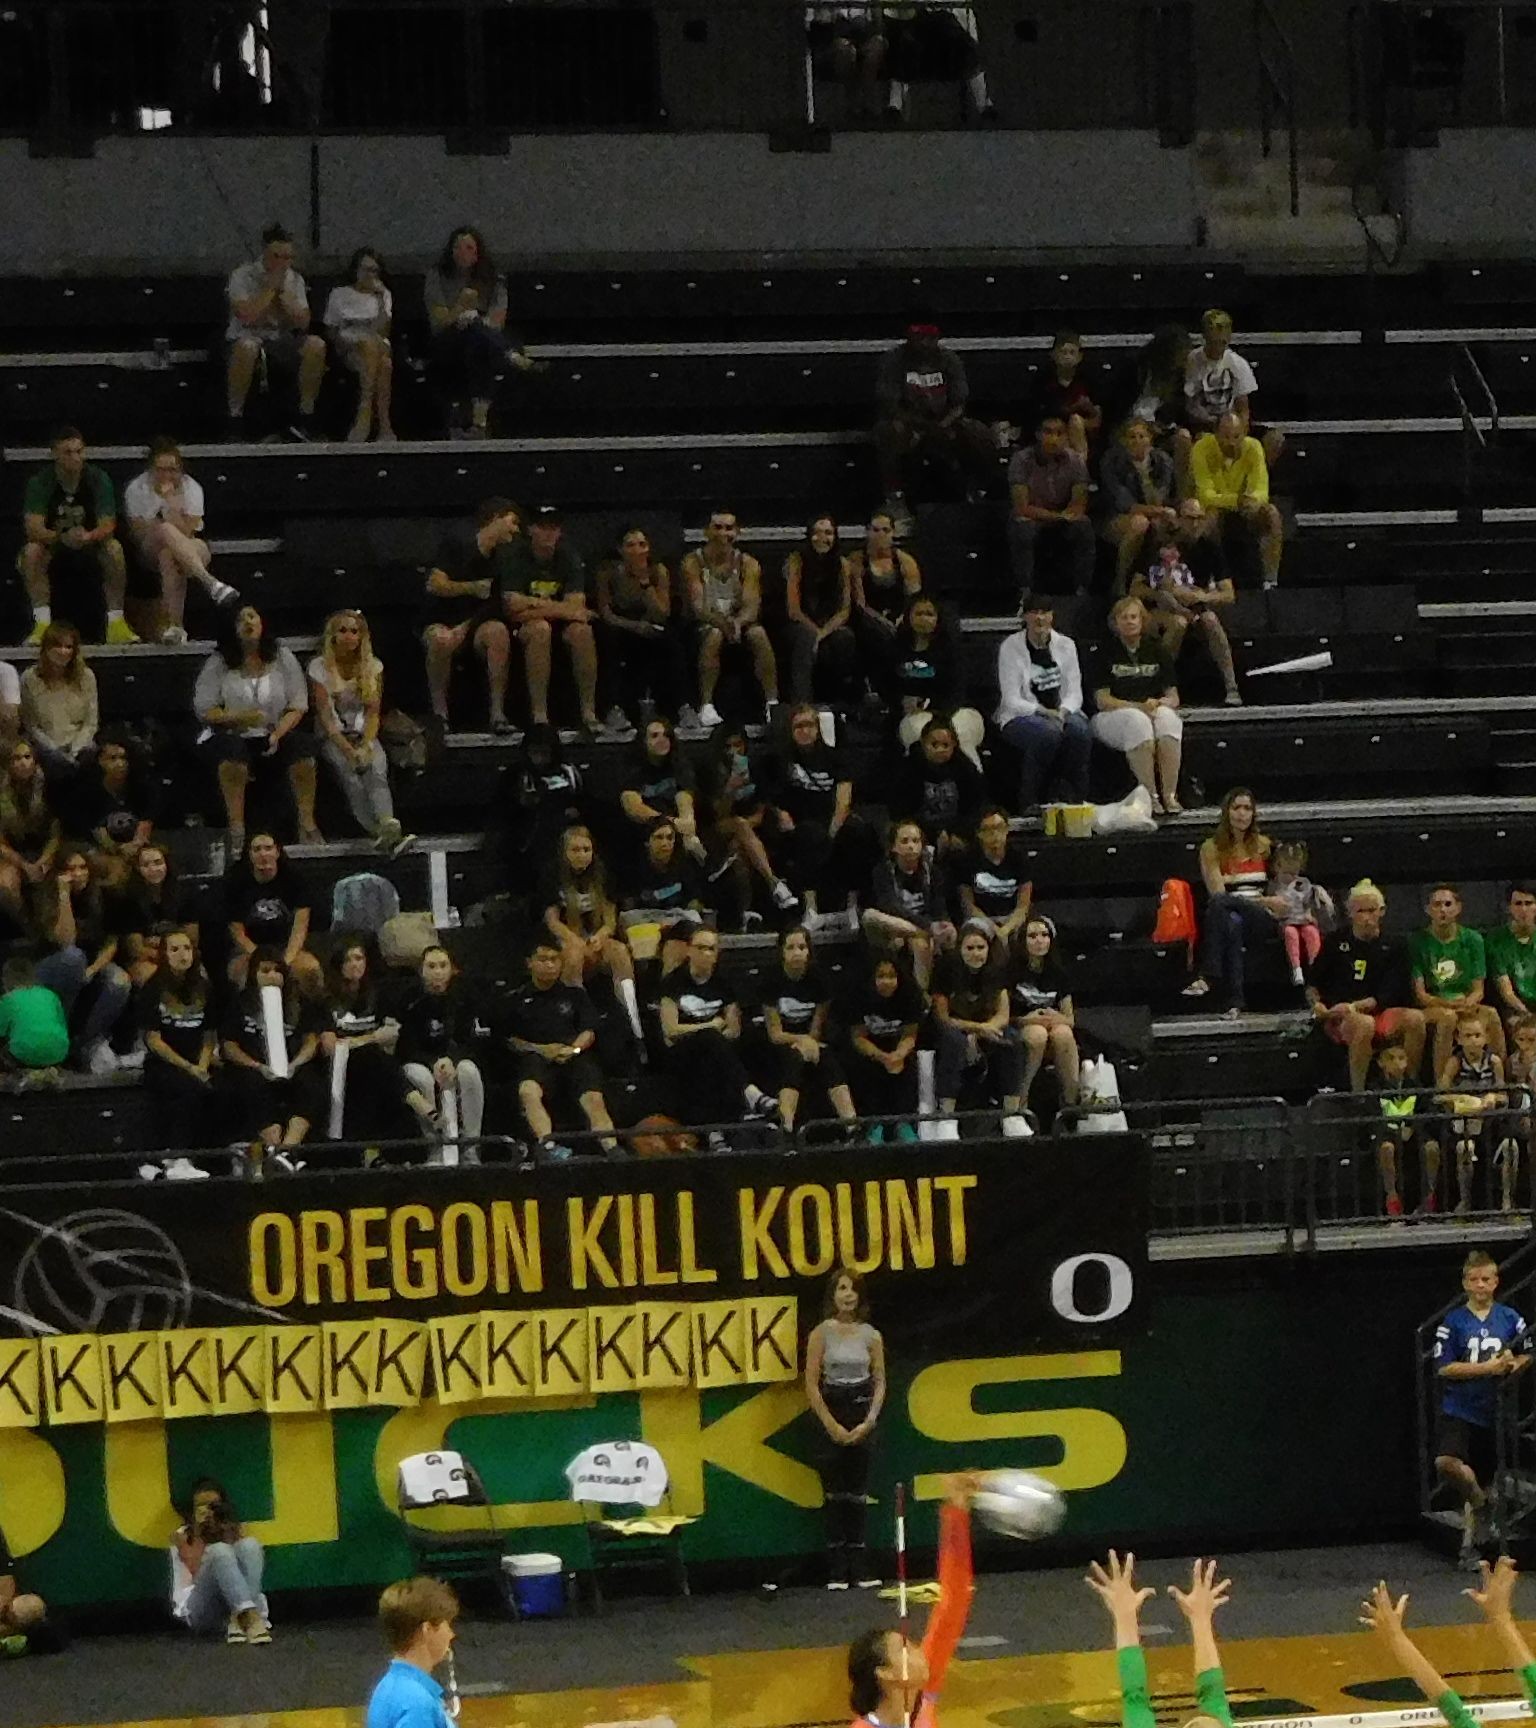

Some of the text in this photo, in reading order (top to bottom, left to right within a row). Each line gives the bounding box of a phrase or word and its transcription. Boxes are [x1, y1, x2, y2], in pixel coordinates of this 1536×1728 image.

[249, 1175, 978, 1307] OREGON KILL KOUNT
[1050, 1252, 1134, 1324] O
